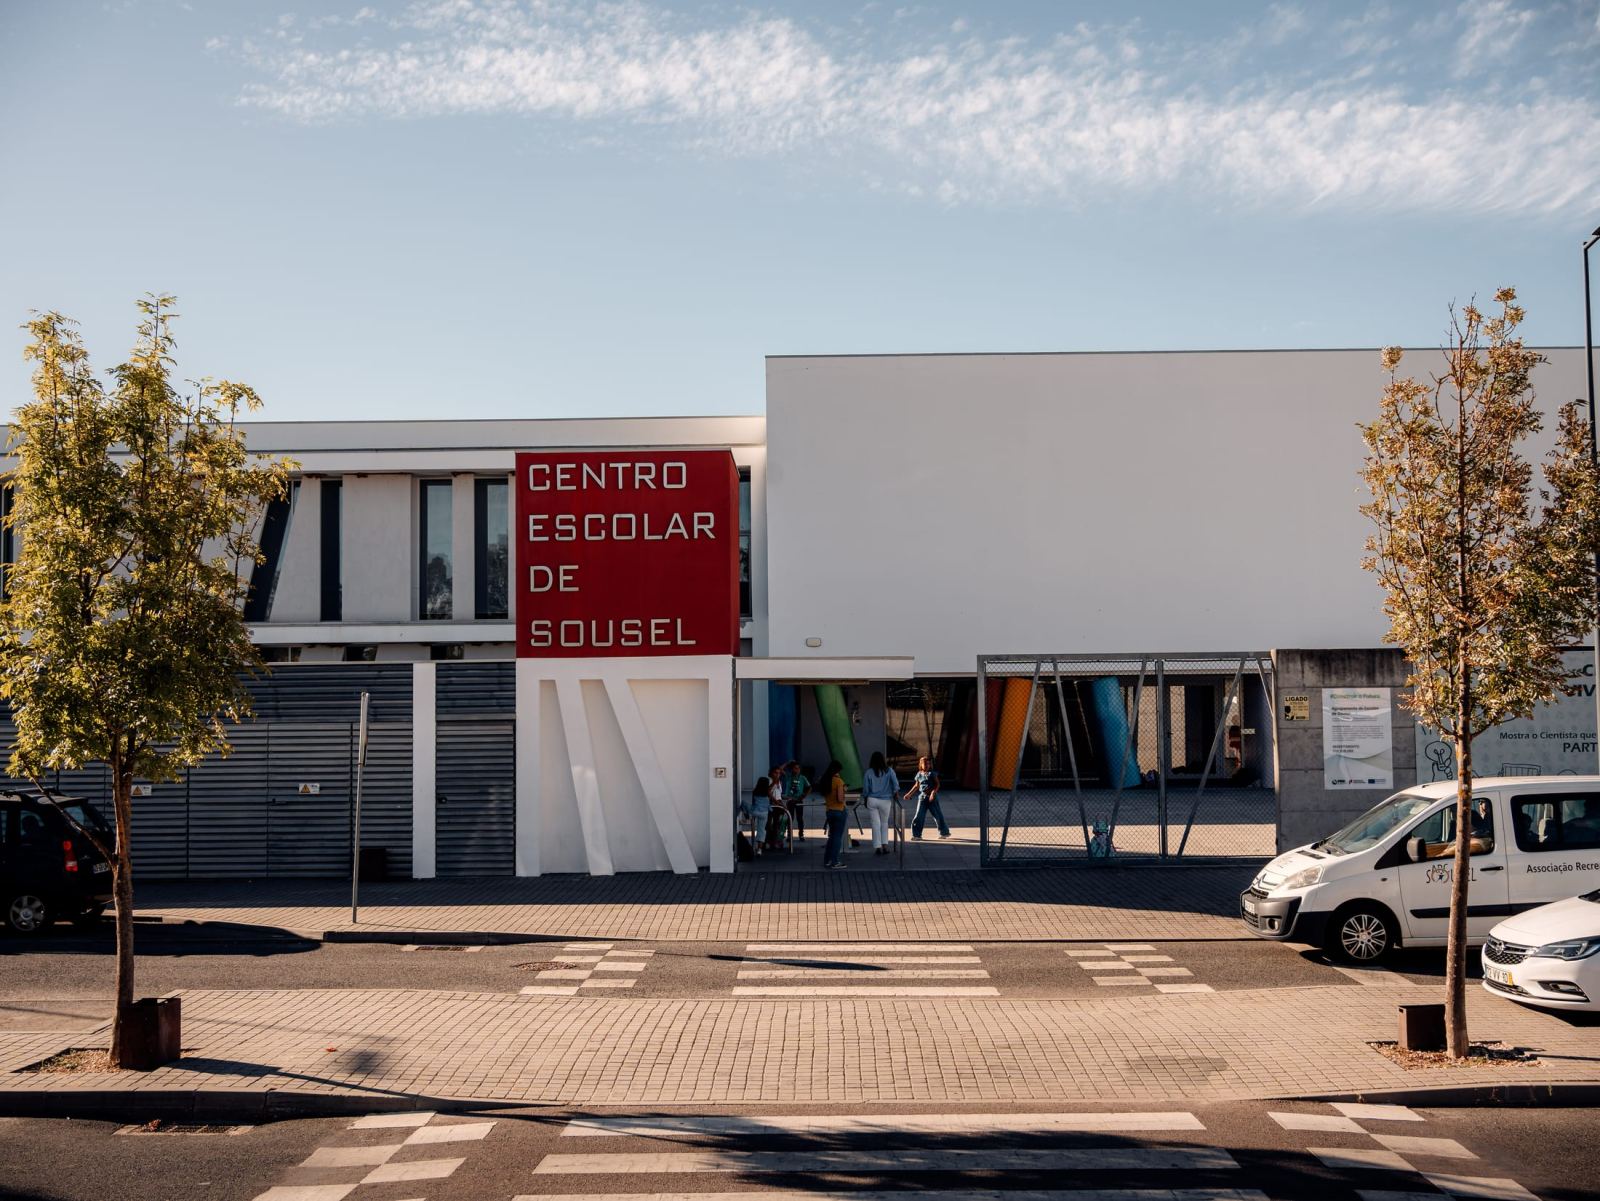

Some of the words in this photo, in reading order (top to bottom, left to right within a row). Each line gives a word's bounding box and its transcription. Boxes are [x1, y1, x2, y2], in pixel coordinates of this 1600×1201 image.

[528, 461, 687, 491] CENTRO
[528, 512, 716, 542] ESCOLAR
[529, 564, 580, 592] DE
[530, 618, 697, 647] SOUSEL
[1499, 731, 1530, 740] Mostra
[1540, 731, 1578, 739] Cientista
[1580, 732, 1597, 741] que
[1526, 862, 1574, 874] Associação
[1575, 861, 1600, 871] Recre
